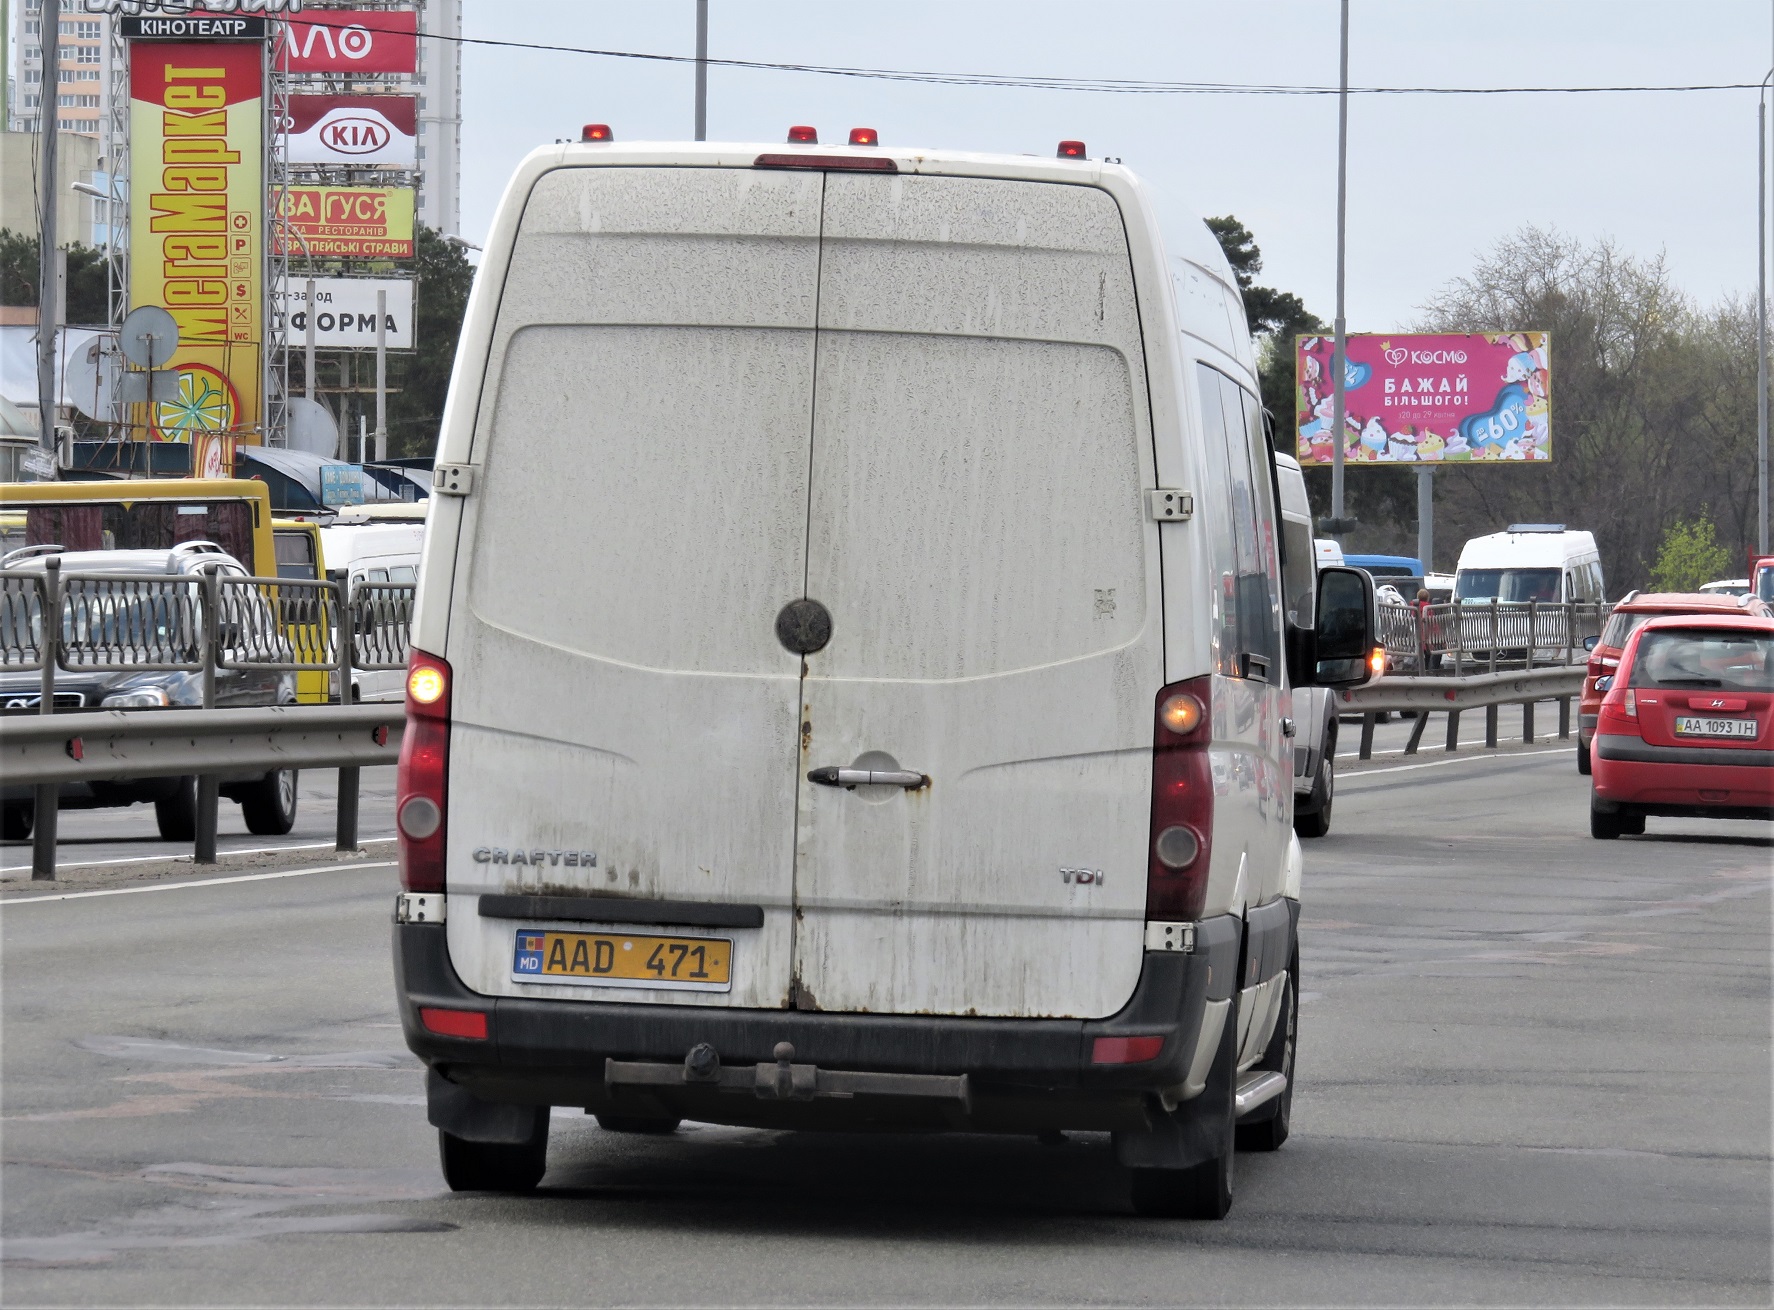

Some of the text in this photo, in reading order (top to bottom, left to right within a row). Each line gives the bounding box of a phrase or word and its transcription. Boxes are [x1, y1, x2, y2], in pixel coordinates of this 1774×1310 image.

[140, 19, 247, 35] КІНОТЕАТР
[332, 126, 379, 146] KIA
[274, 193, 387, 220] ВА ГУСЯ
[318, 227, 384, 236] РЕСТОРАНІВ
[235, 239, 246, 251] P
[363, 242, 408, 254] СТРАВИ
[234, 332, 249, 340] WC
[1411, 350, 1468, 364] КОСМО
[1384, 374, 1468, 393] БАЖАЙ
[1384, 396, 1468, 406] БІЛЬШОГО!
[1684, 719, 1754, 735] AA 1093 IH
[472, 846, 597, 867] CRAFTER
[1059, 867, 1104, 886] TDI
[519, 957, 539, 970] MD
[546, 938, 709, 979] AAD 471
